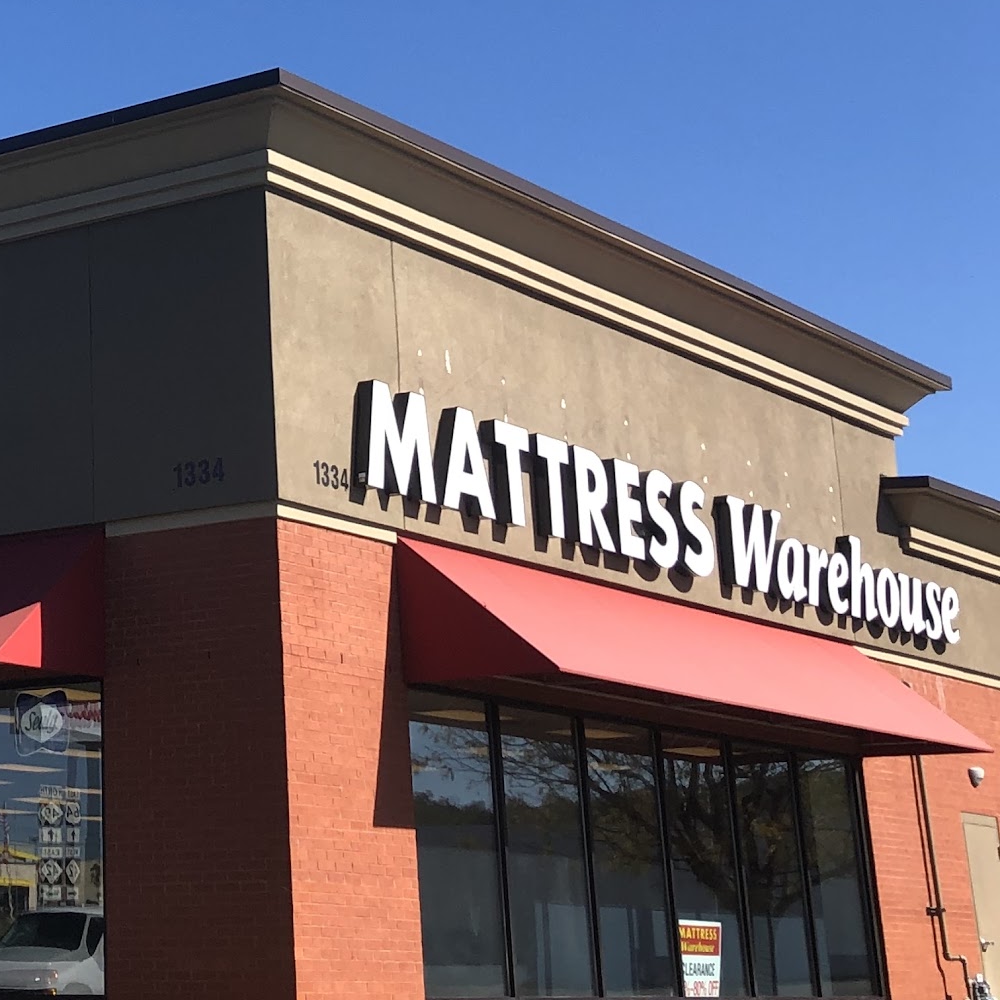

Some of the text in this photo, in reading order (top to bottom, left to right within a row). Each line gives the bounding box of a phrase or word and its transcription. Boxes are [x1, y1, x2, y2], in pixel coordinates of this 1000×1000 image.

[173, 457, 225, 488] 1334
[313, 459, 349, 492] 1334
[366, 379, 961, 645] MATTRESS Warehouse
[678, 926, 718, 940] MATTRESS
